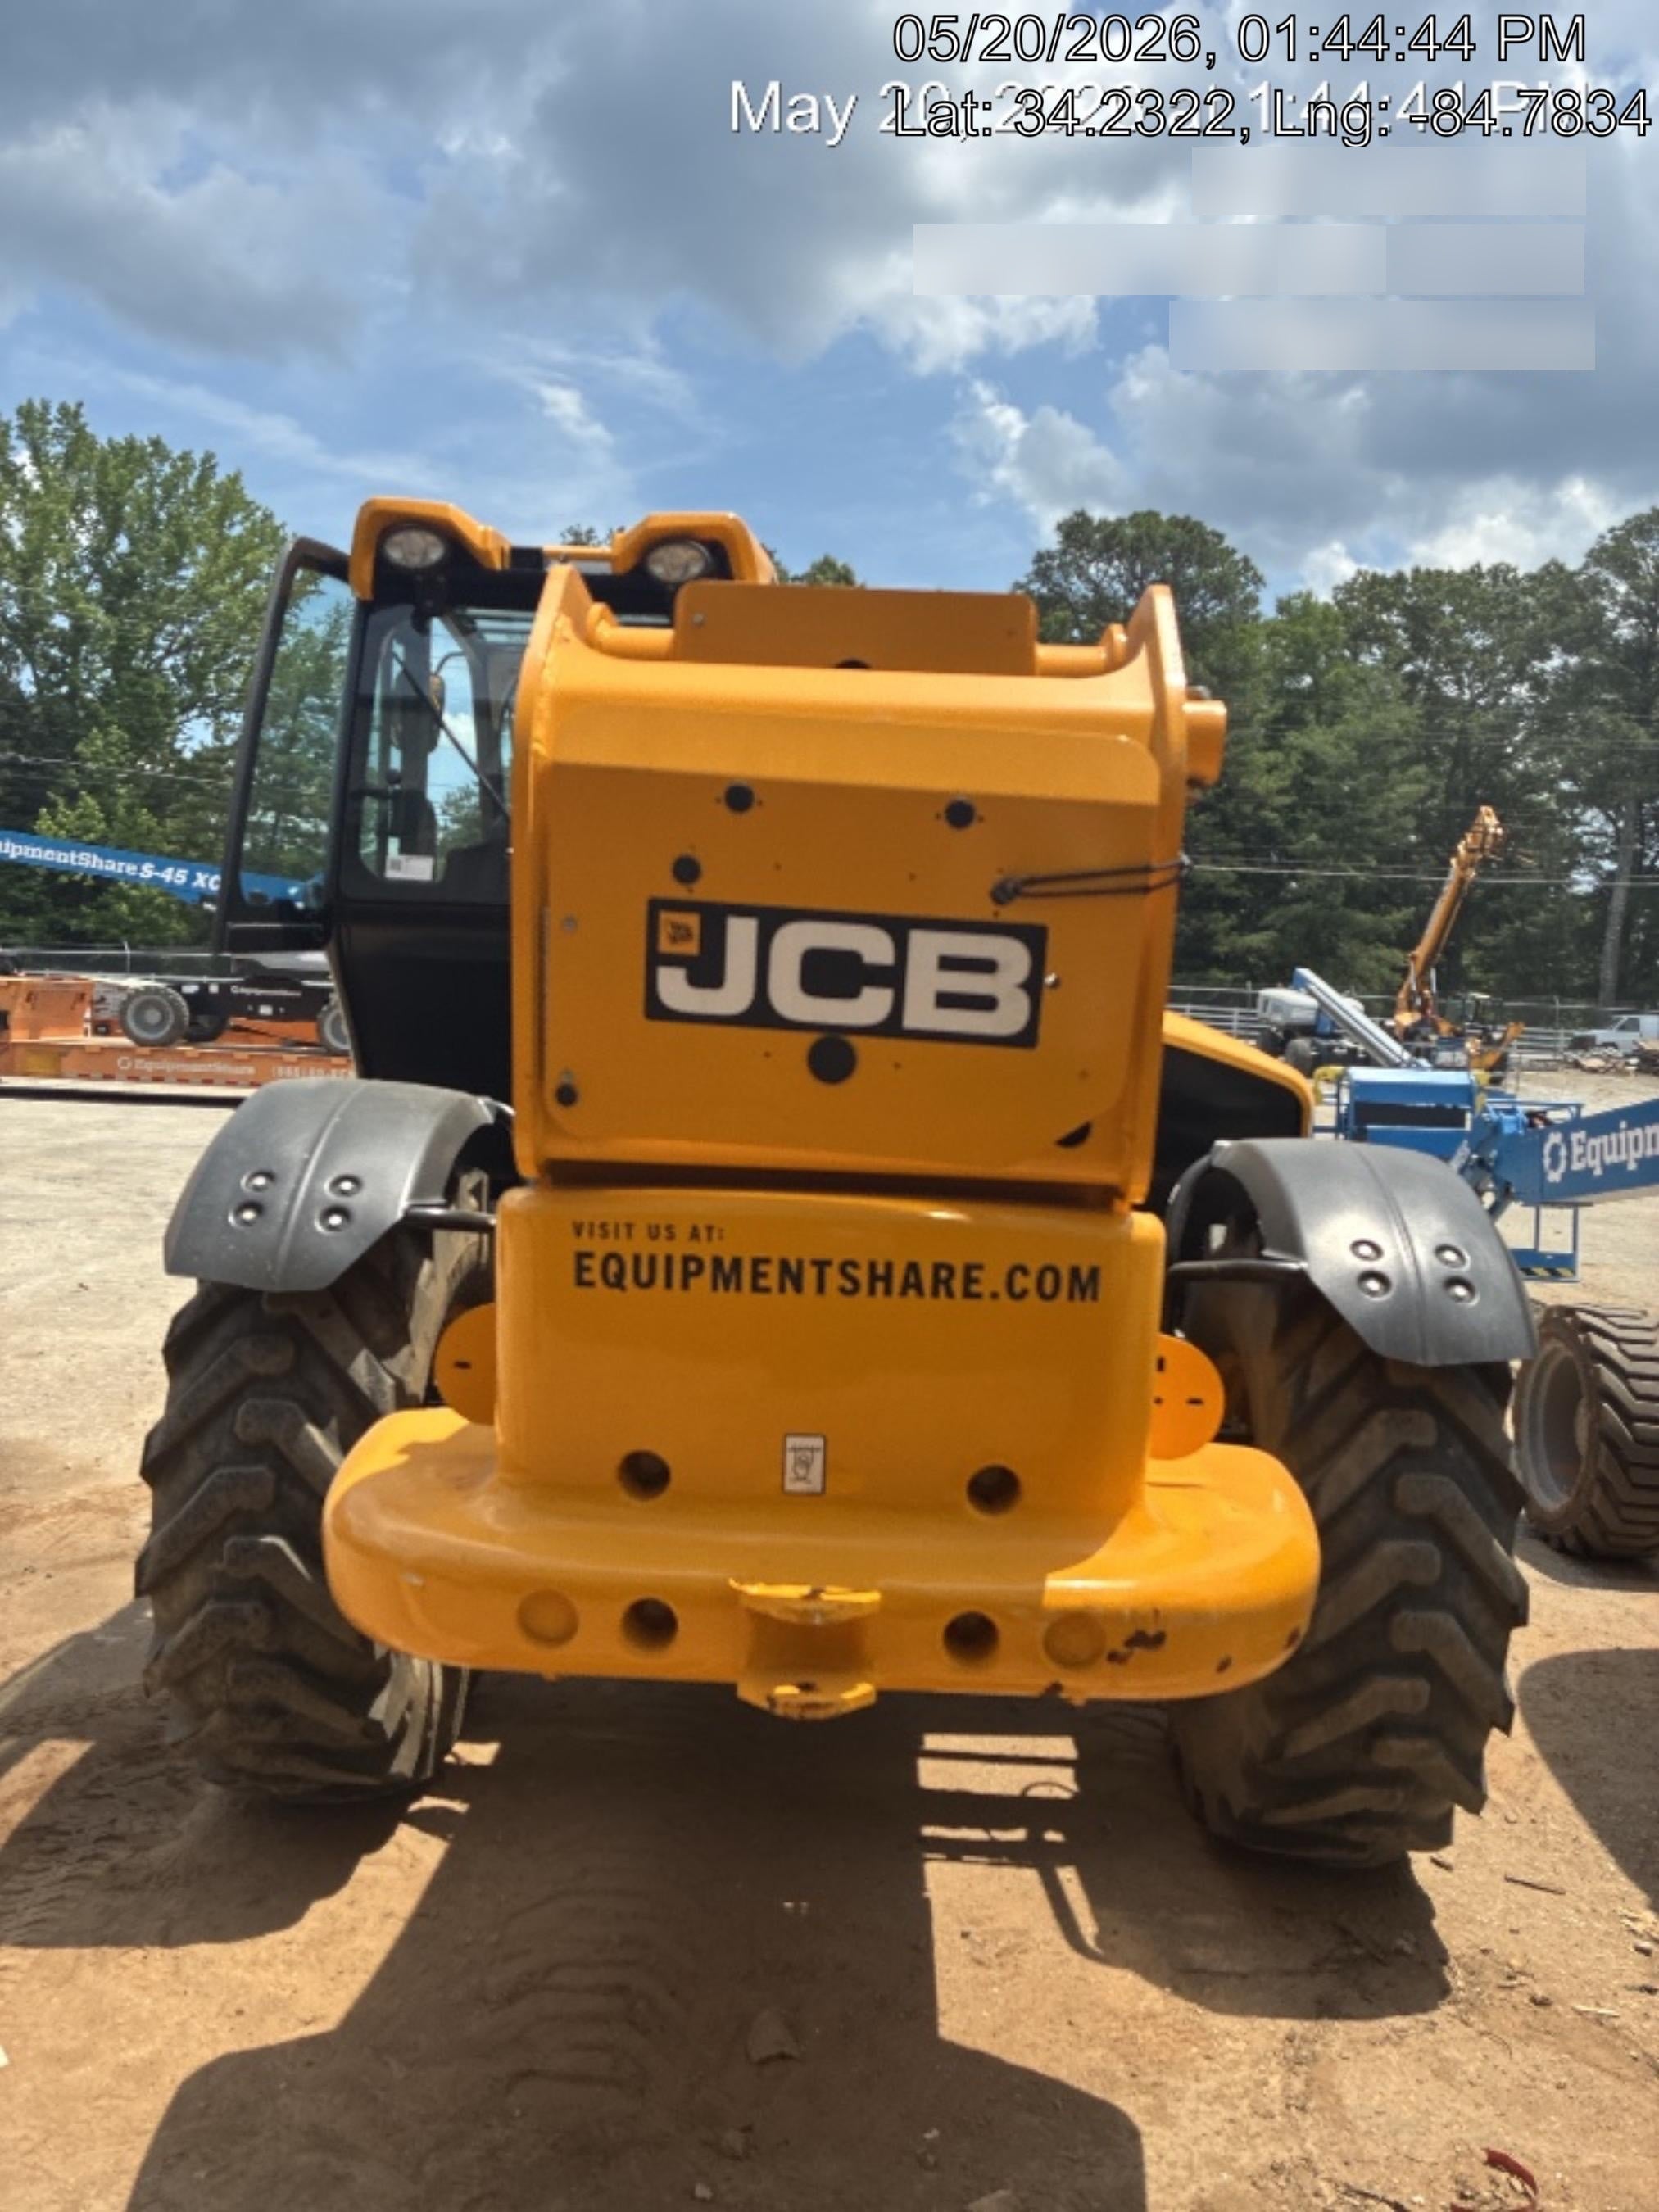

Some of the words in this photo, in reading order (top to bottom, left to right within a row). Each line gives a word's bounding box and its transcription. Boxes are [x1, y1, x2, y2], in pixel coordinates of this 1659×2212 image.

[138, 863, 188, 886] S-45
[655, 914, 1032, 1037] JCB
[573, 1221, 635, 1240] VISIT
[646, 1222, 677, 1241] US
[688, 1224, 724, 1243] AT:
[573, 1250, 1102, 1303] EQUIPMENTSHARE.COM
